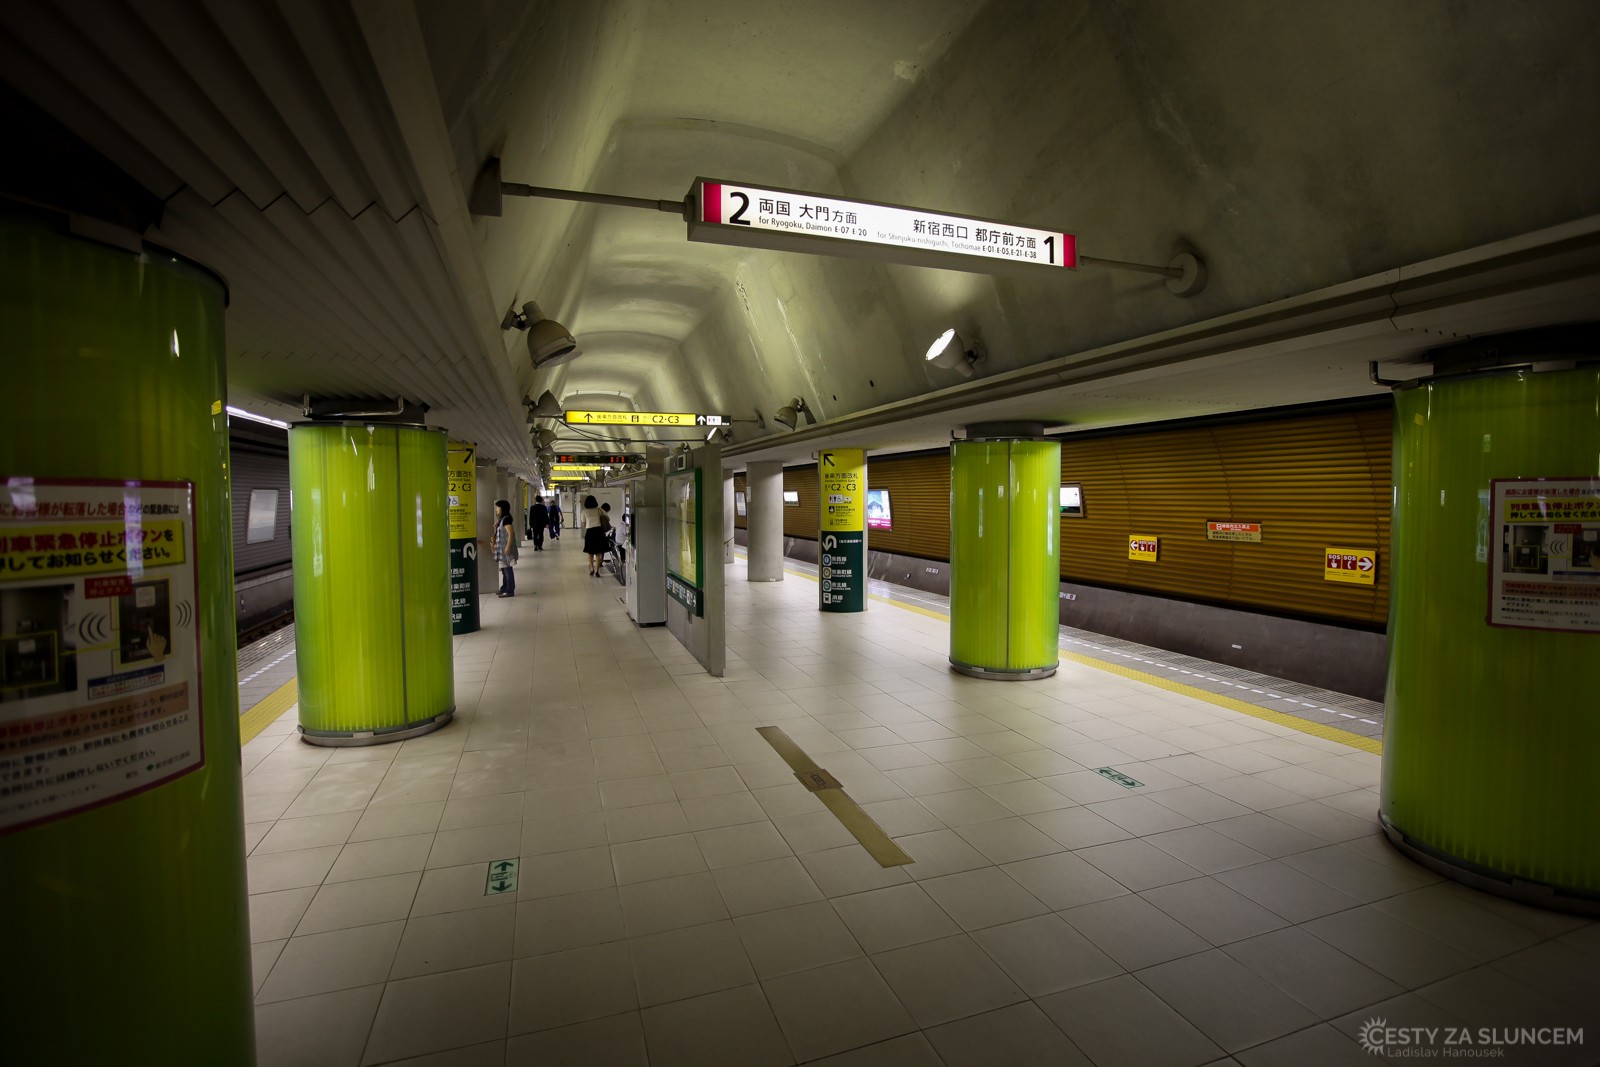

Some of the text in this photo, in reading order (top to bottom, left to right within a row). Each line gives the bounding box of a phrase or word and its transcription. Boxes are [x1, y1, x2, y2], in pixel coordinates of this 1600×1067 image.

[729, 191, 751, 226] 2
[758, 198, 858, 225] 両国 大門方面
[758, 216, 770, 225] for
[771, 217, 804, 231] Ryogoku,
[805, 222, 832, 233] Daimon
[913, 219, 1036, 249] 新宿西口 都庁前方面
[877, 231, 887, 239] for
[951, 240, 981, 252] Tochomae
[1043, 236, 1055, 264] 1
[0, 547, 171, 572] してお知らせください。
